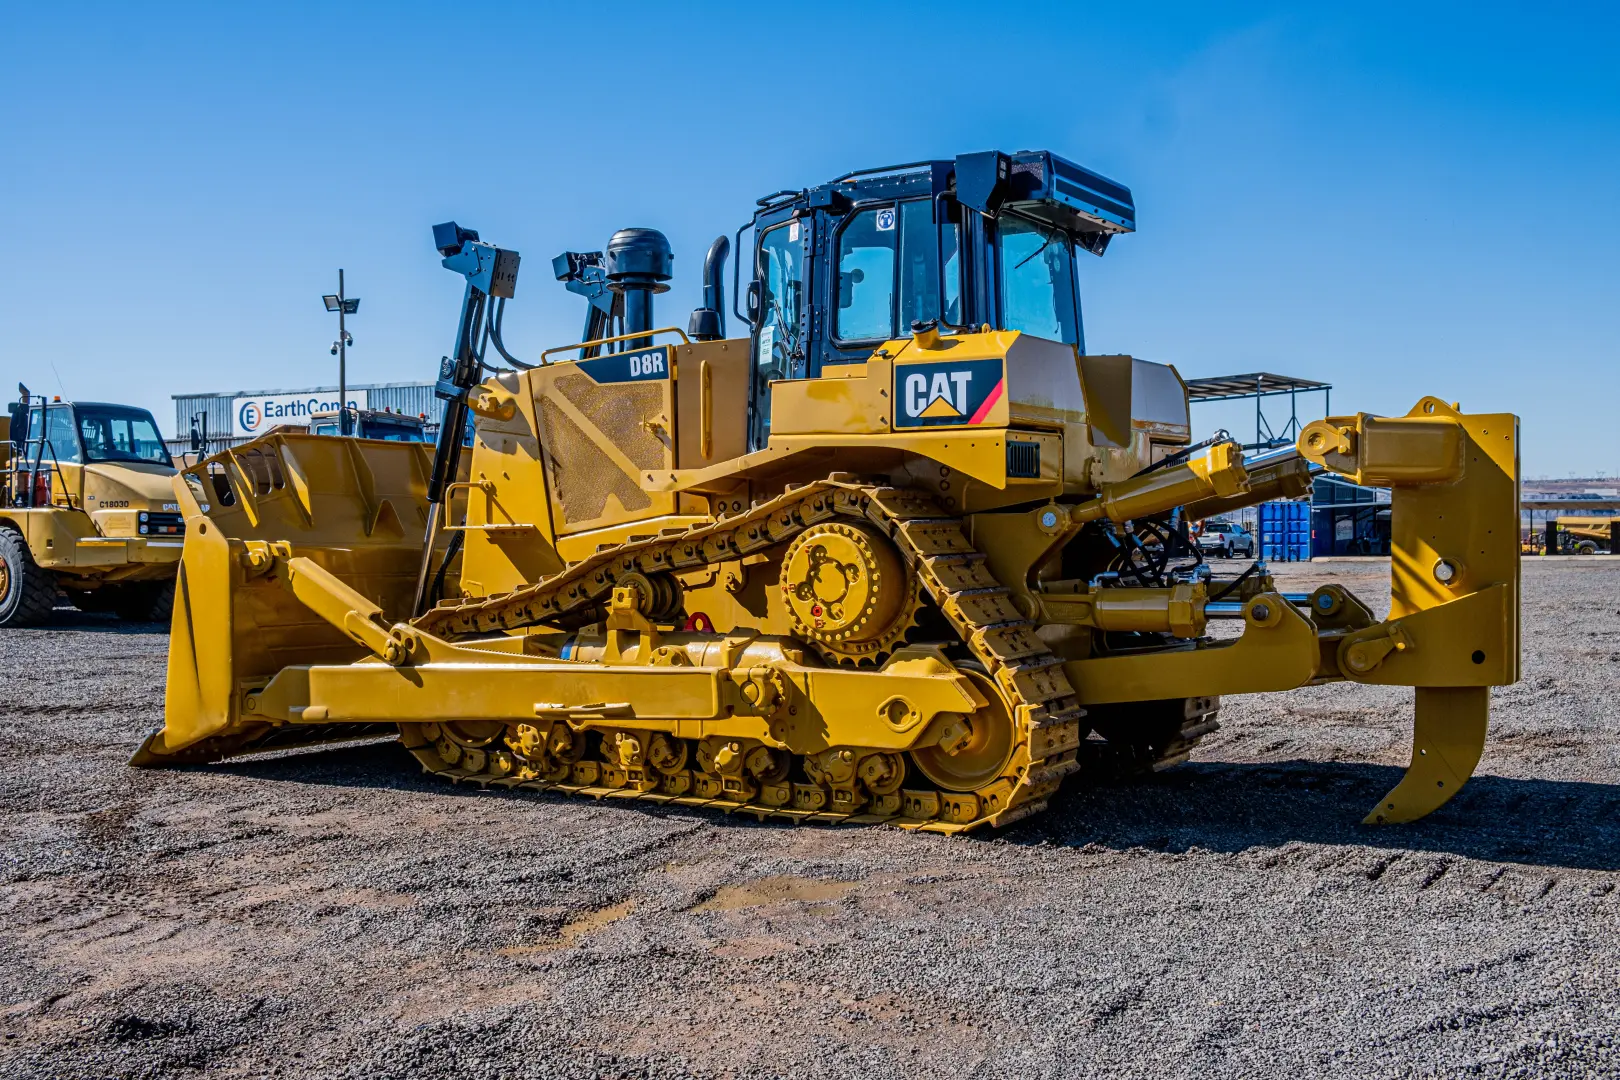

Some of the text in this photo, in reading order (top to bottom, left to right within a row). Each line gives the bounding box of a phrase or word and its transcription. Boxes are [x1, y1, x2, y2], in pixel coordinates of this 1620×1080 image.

[630, 352, 664, 377] D8R
[905, 371, 972, 418] CAT
[99, 500, 129, 509] C18030
